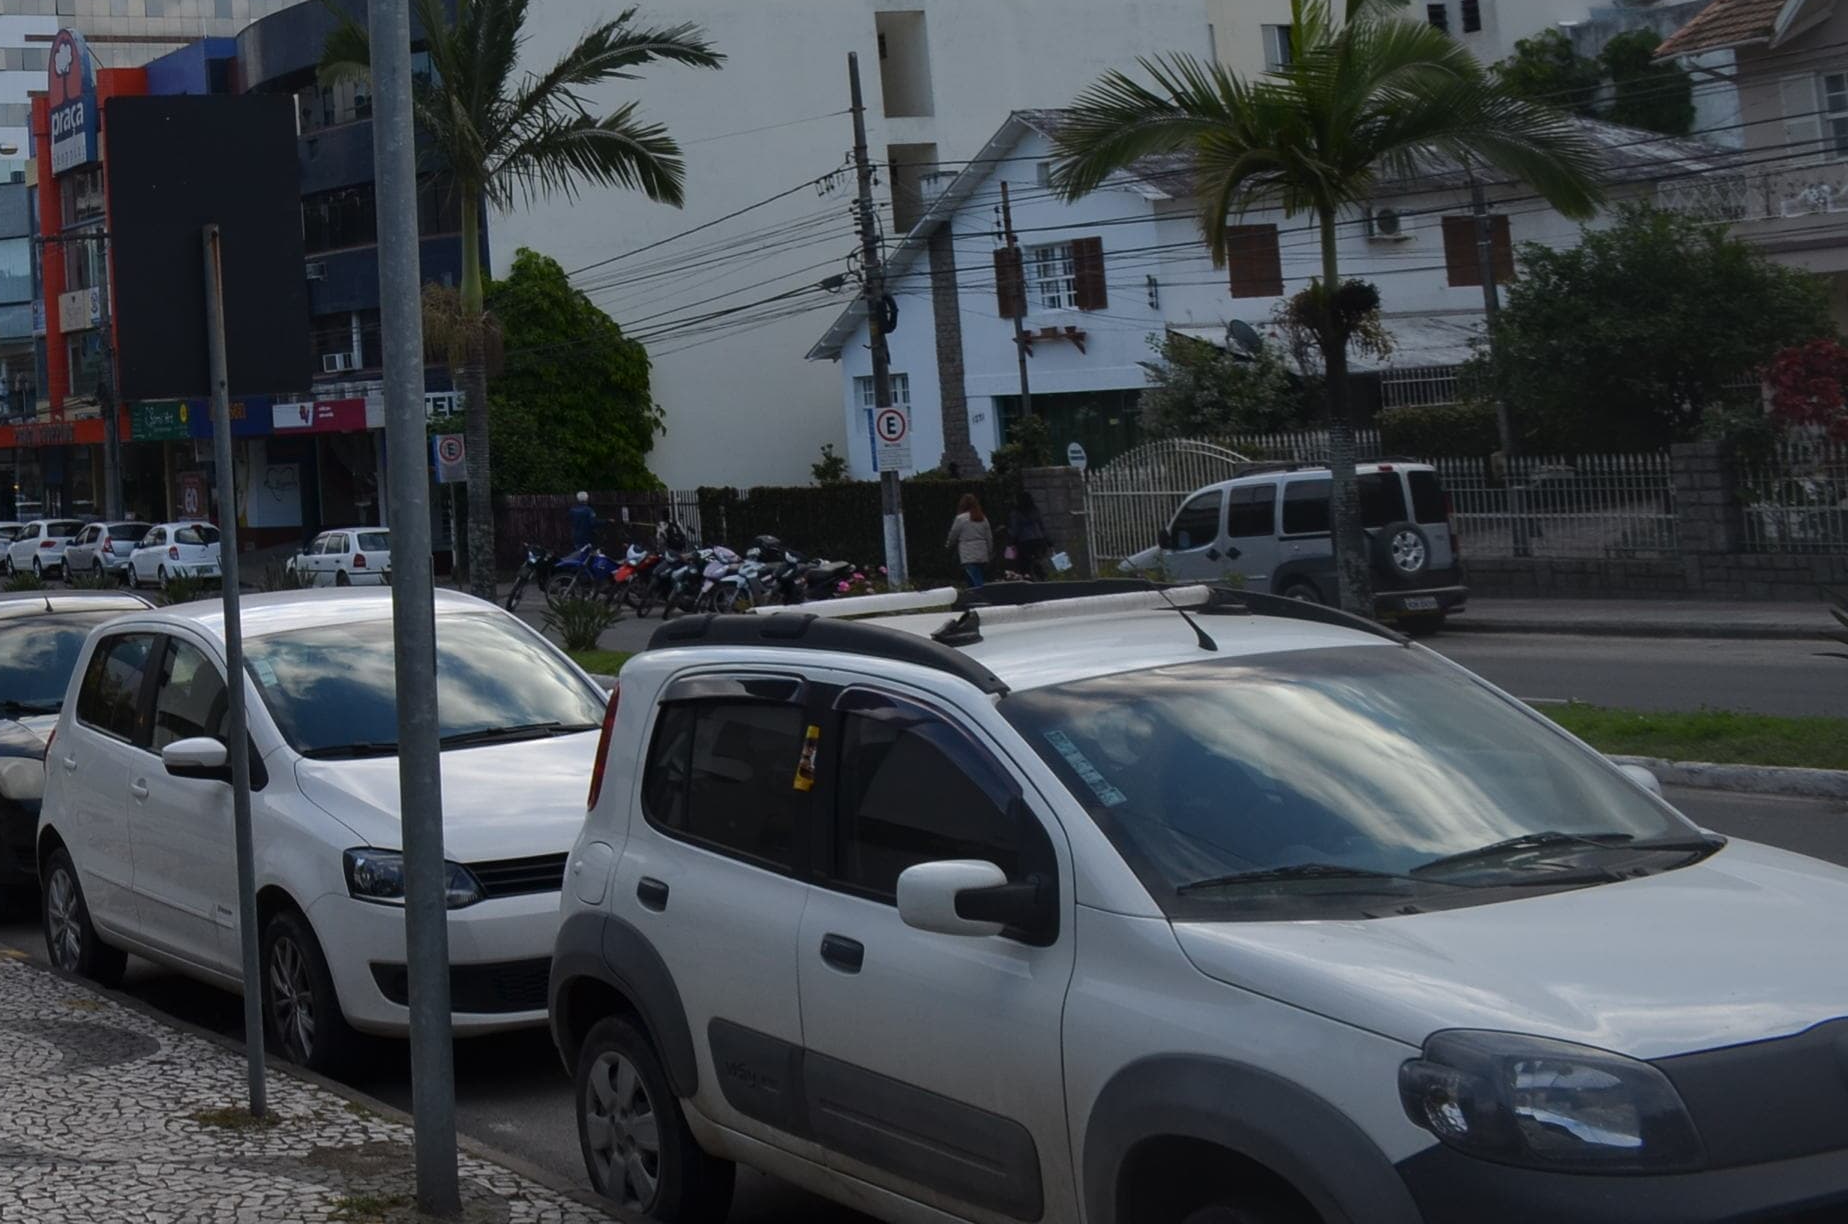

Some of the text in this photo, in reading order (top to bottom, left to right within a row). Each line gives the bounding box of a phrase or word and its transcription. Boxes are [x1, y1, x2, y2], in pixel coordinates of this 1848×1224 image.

[52, 102, 84, 137] praça
[886, 416, 897, 434] E
[446, 442, 456, 456] E
